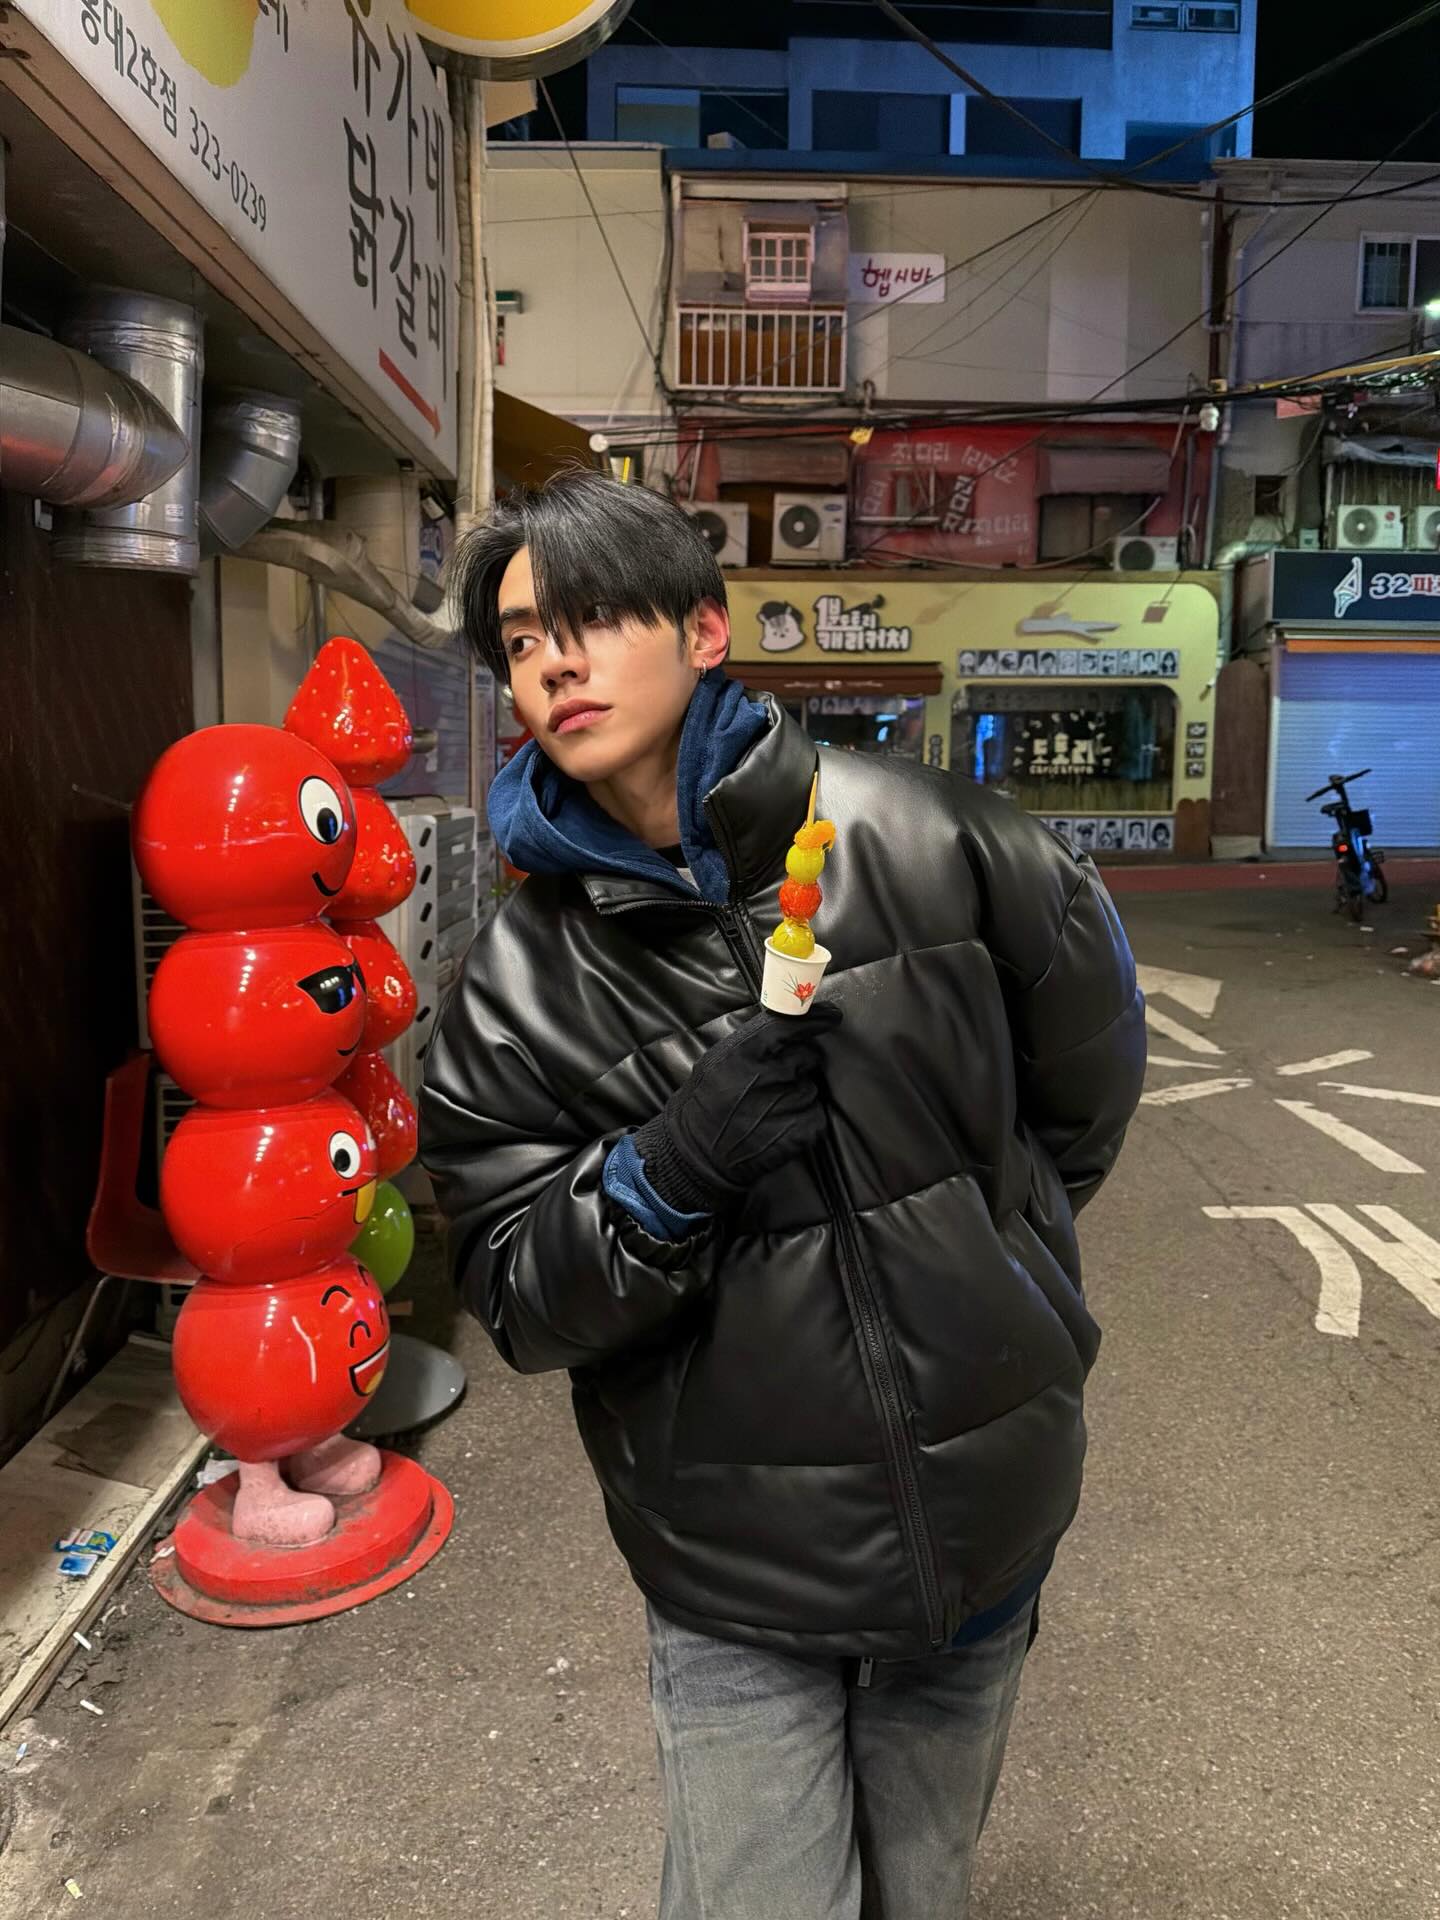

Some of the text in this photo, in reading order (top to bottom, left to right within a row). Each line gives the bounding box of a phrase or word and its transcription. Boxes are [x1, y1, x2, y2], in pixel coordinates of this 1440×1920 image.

[189, 106, 266, 232] 323-0239
[343, 116, 447, 402] 닭갈비
[1030, 732, 1096, 765] 도토리
